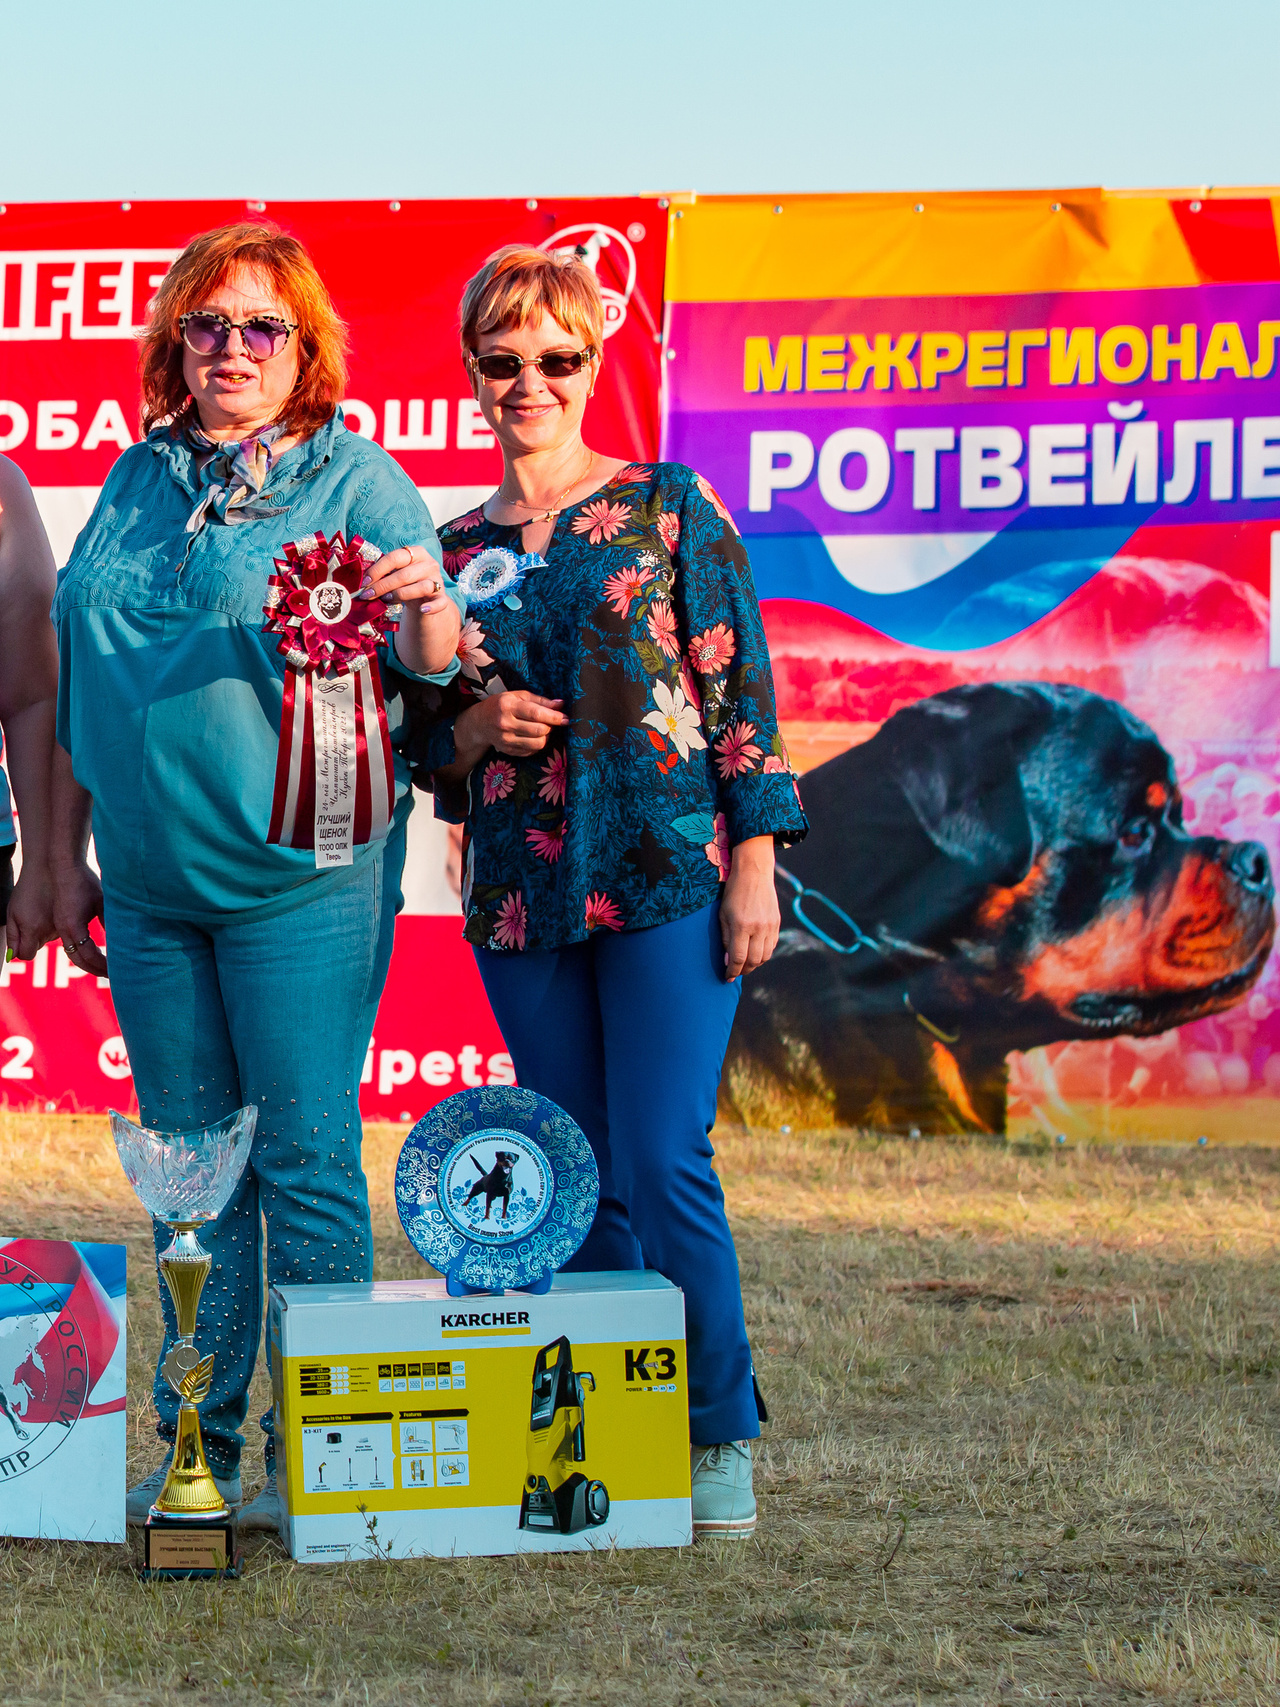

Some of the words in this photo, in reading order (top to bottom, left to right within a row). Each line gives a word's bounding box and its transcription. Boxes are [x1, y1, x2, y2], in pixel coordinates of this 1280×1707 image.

[338, 398, 495, 450] ОШЕ
[747, 400, 1280, 513] РОТВЕЙЛЕ
[339, 771, 352, 799] Кубок
[317, 811, 351, 825] ЛУЧШИЙ
[319, 827, 348, 840] ЩЕНОК
[326, 853, 341, 861] Тверь
[467, 1223, 480, 1234] Best
[440, 1311, 530, 1328] KÄRCHER
[44, 1299, 86, 1428] РОССИИ
[625, 1347, 677, 1381] K3
